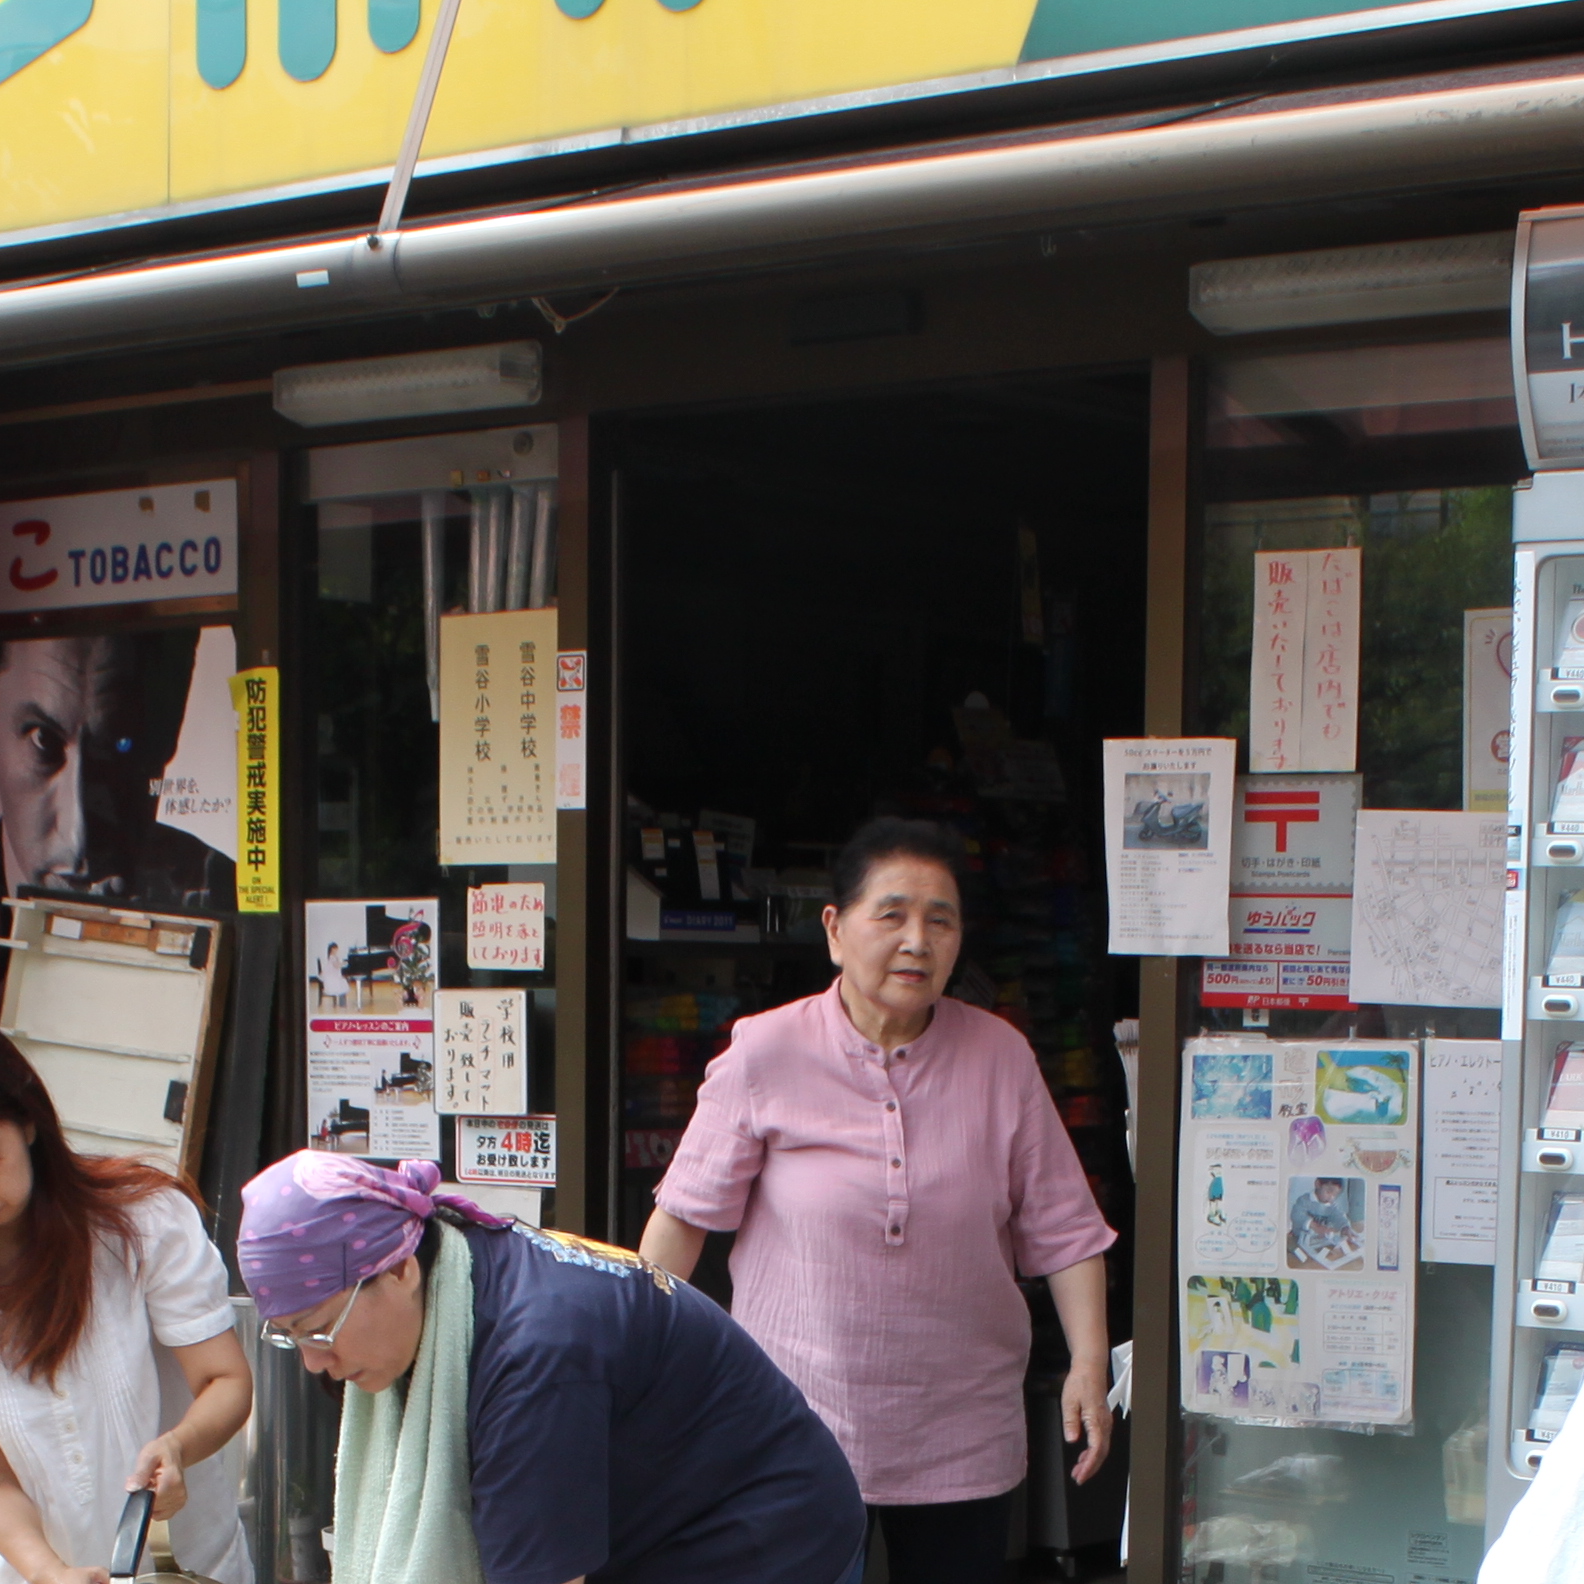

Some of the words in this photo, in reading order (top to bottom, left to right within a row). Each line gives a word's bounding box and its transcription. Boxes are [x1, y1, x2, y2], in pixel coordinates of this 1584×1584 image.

[69, 535, 222, 587] TOBACCO
[474, 644, 491, 762] 雪谷小学校
[519, 641, 537, 759] 雪谷中学校
[245, 678, 267, 872] 防犯警戒実施中
[1241, 857, 1322, 869] 切手・はがき・印紙
[471, 891, 545, 915] 節電のため
[1247, 910, 1317, 927] ゆうパック
[443, 1027, 460, 1109] おります。
[479, 1019, 492, 1112] ランチマット
[496, 999, 516, 1069] 学校用
[476, 1153, 551, 1168] お受け致します
